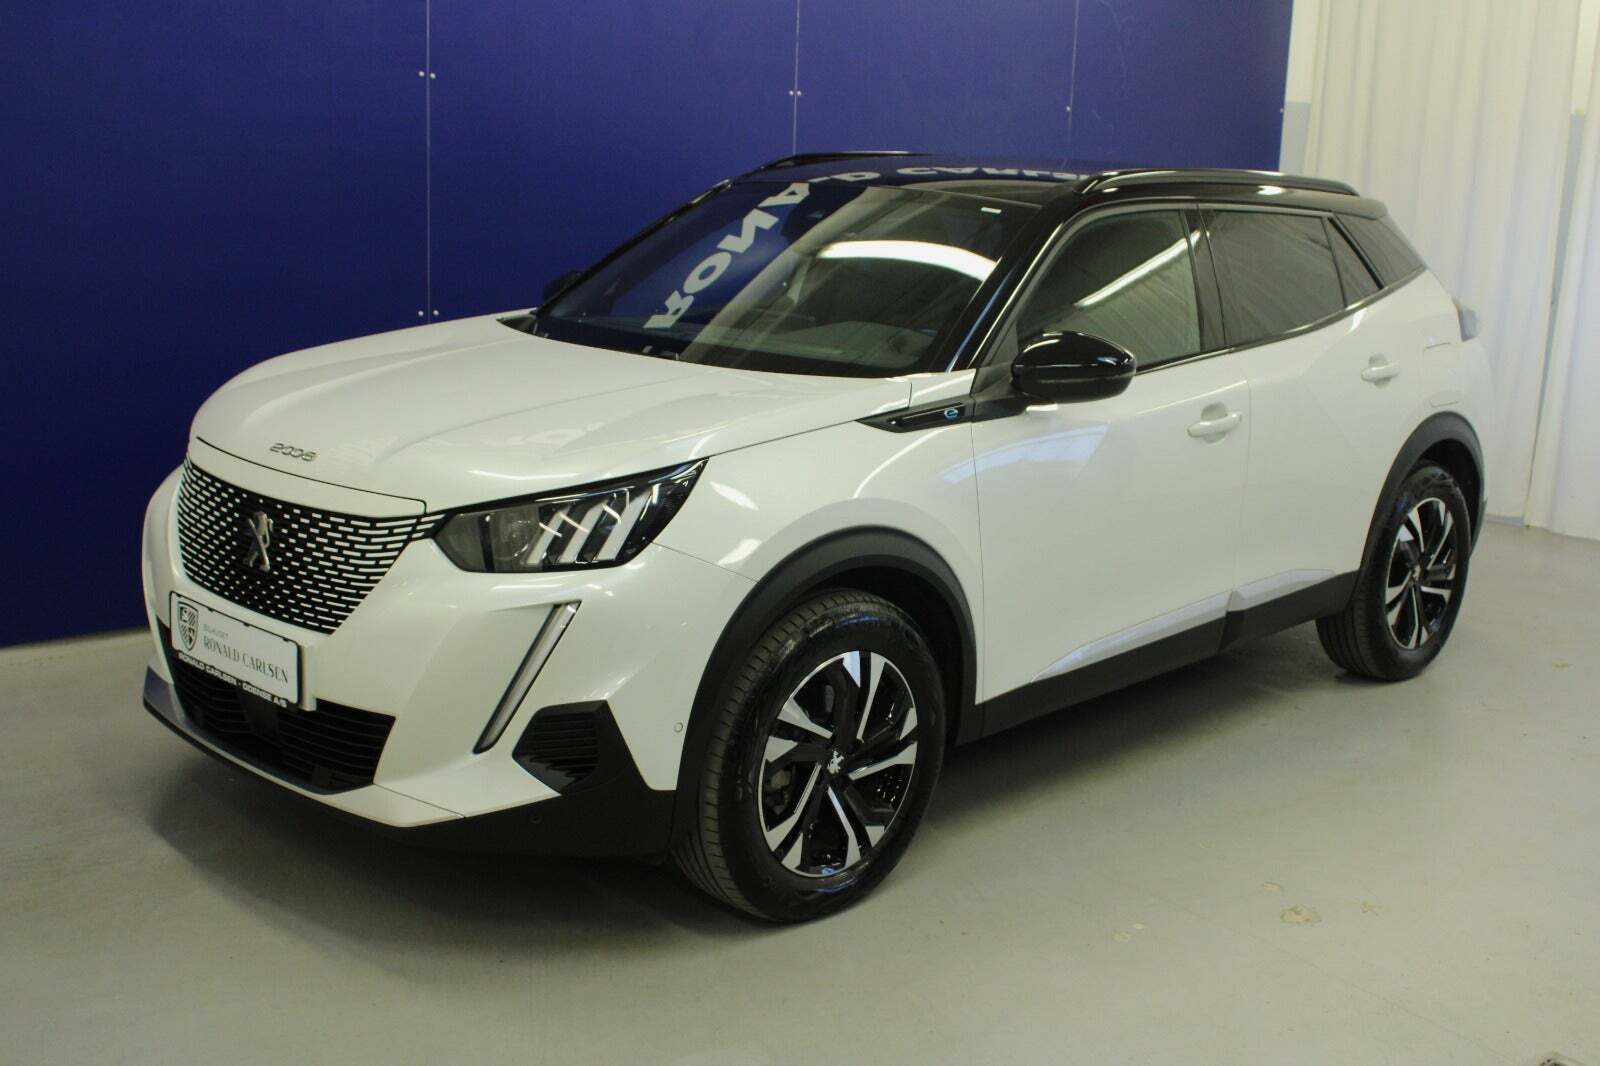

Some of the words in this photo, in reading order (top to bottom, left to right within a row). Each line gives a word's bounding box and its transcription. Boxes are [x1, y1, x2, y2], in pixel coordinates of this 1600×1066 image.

[269, 442, 317, 462] 2008
[203, 635, 240, 663] RONALD
[242, 652, 288, 684] CARLSEN
